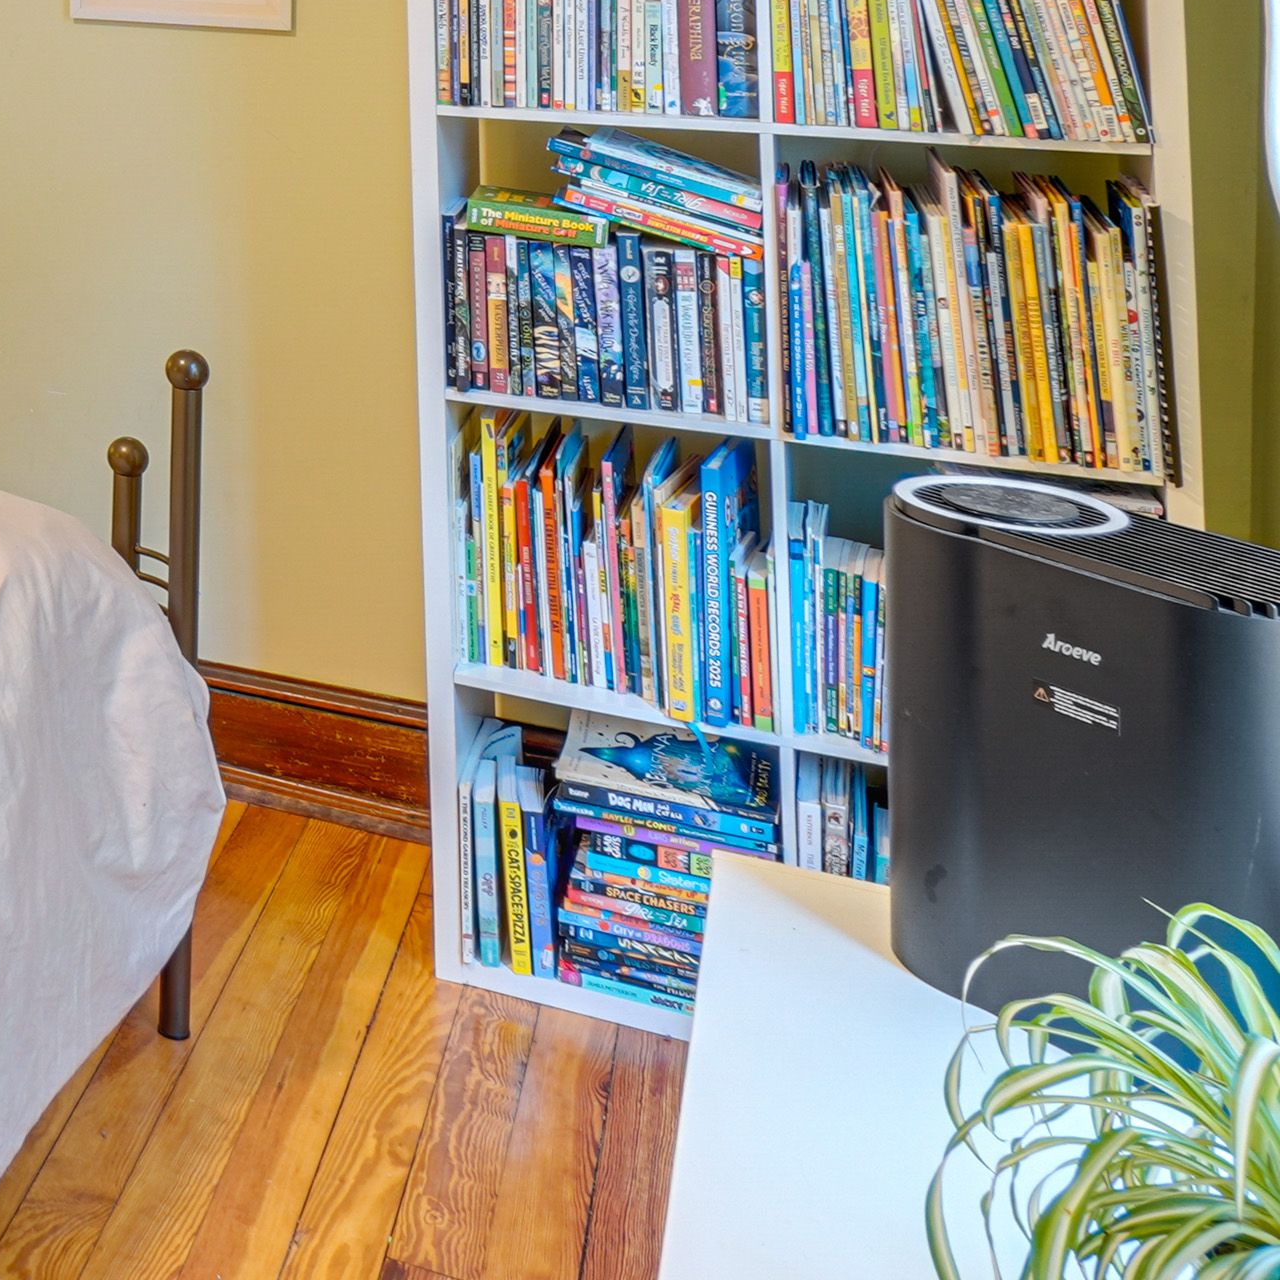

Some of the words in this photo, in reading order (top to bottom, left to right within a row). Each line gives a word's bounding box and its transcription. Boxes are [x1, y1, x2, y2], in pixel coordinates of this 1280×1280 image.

[479, 217, 494, 227] of
[495, 219, 550, 235] Miniature
[480, 207, 503, 220] The
[504, 211, 560, 228] Miniature
[561, 218, 594, 233] Book
[544, 508, 553, 520] THE
[705, 492, 718, 550] GUINNESS
[547, 566, 556, 591] LITTLE
[706, 554, 718, 598] WORLD
[550, 595, 558, 615] PUSSY
[552, 620, 560, 634] CAT
[708, 601, 720, 656] RECORDS
[1042, 633, 1102, 666] Aroeve
[709, 658, 722, 688] 2025
[607, 793, 630, 808] DOG
[508, 849, 521, 870] CAT
[508, 873, 523, 907] SPACE
[658, 871, 708, 891] Sisters
[606, 886, 641, 903] SPACE
[642, 896, 696, 914] CHASERS
[511, 913, 526, 944] PIZZA
[613, 924, 634, 937] CITY
